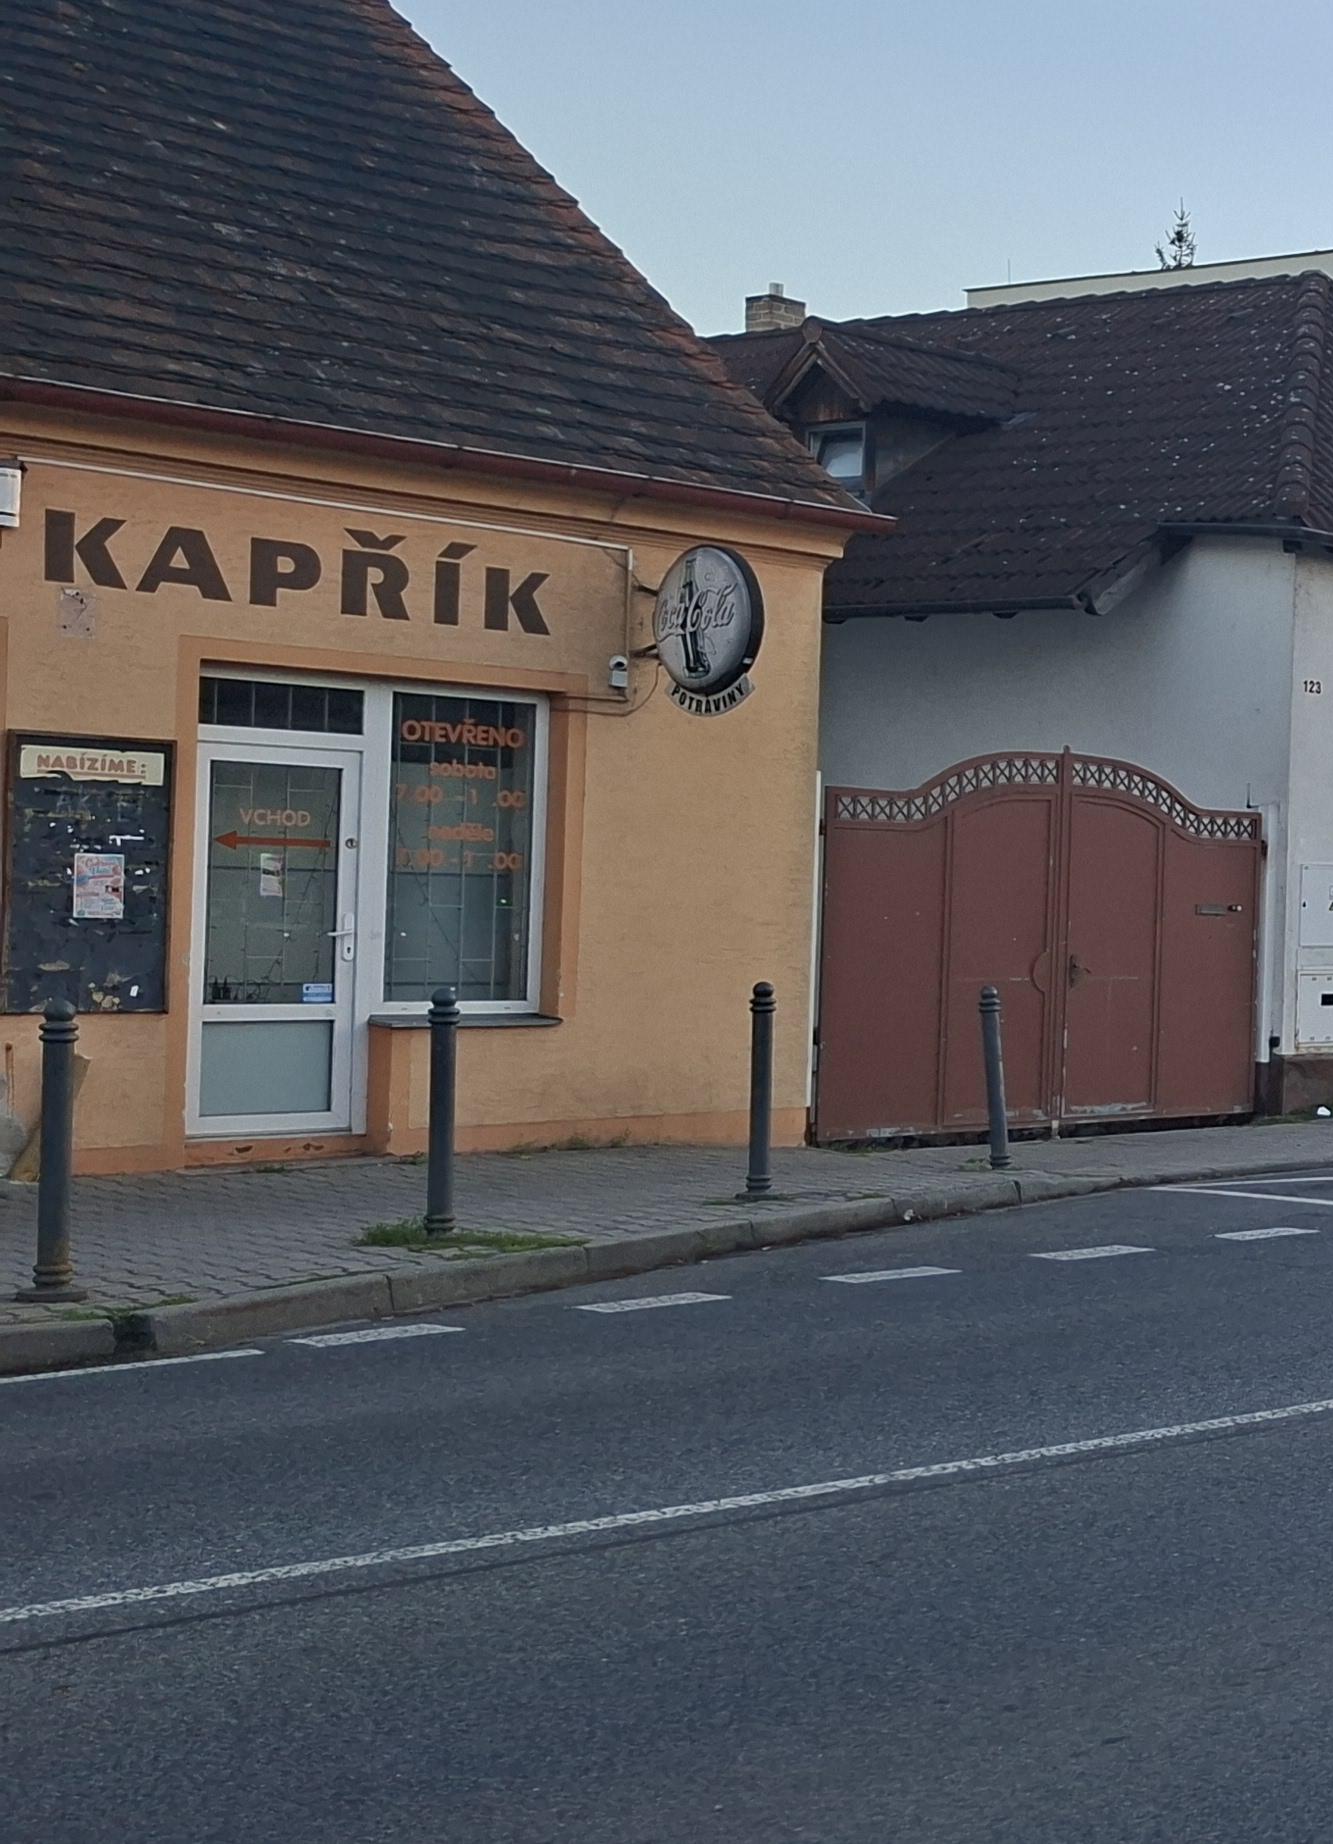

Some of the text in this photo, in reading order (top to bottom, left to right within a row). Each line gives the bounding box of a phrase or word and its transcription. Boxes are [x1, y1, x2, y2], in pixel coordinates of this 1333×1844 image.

[45, 509, 550, 636] KAPŘÍK
[671, 682, 745, 714] POTRAVINY
[1303, 680, 1322, 695] 123
[402, 718, 525, 749] OTEVŘENO
[429, 760, 497, 779] sobota
[239, 807, 311, 827] VCHOD
